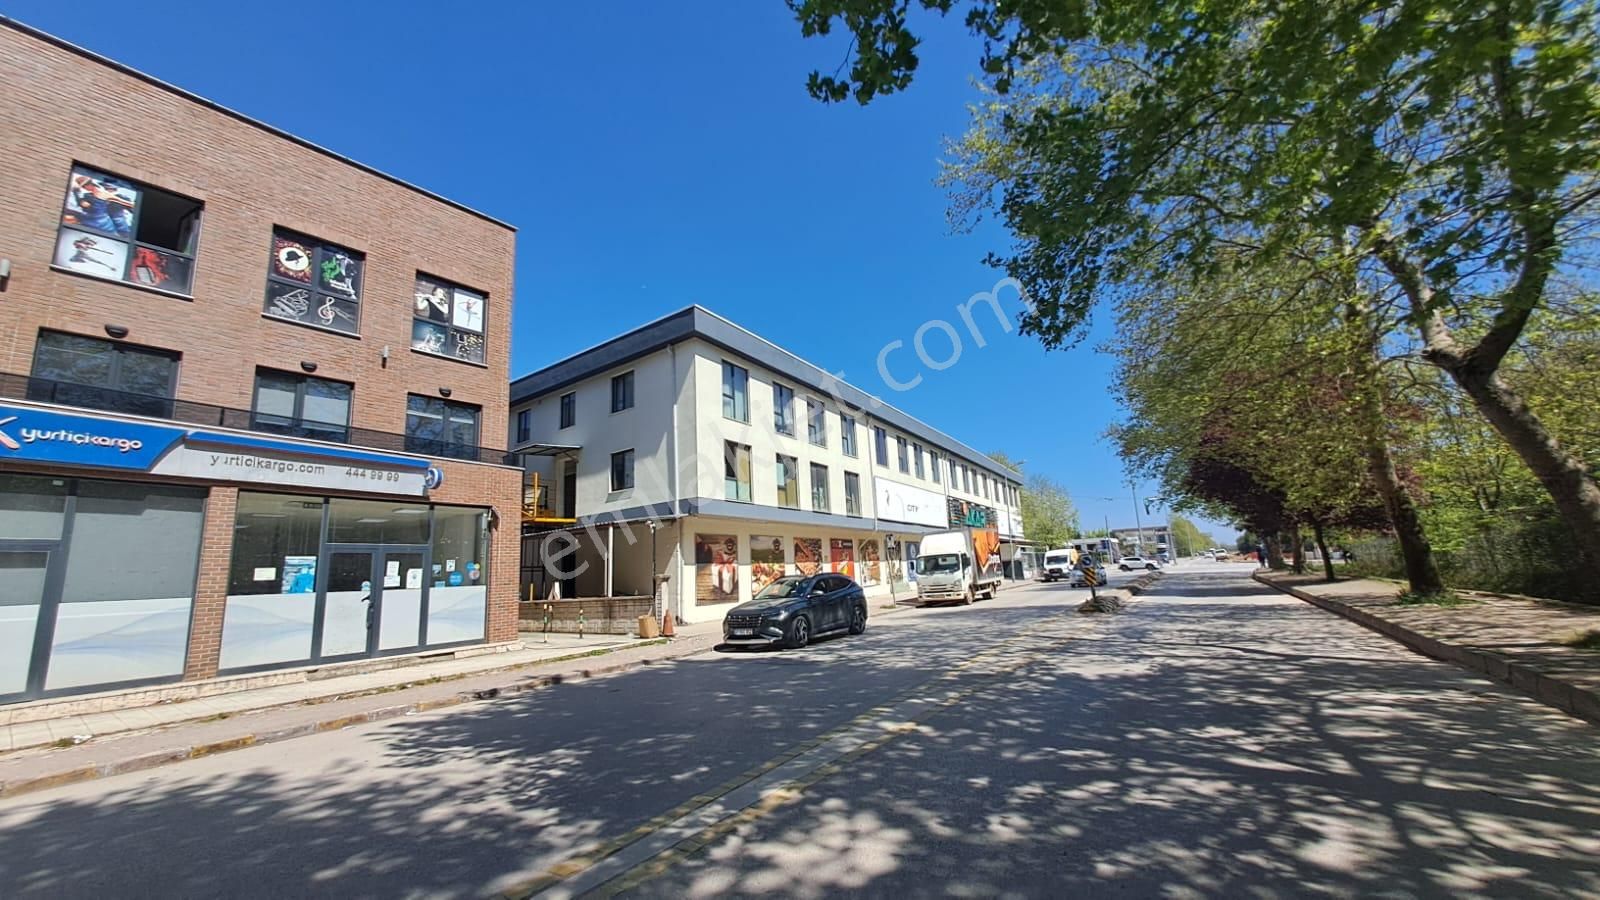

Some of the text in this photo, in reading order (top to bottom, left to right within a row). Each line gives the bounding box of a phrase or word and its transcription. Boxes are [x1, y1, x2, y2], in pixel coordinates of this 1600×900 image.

[21, 428, 143, 452] yurtiçikargo
[345, 468, 366, 479] 444
[371, 470, 383, 480] 99
[387, 472, 399, 482] 99
